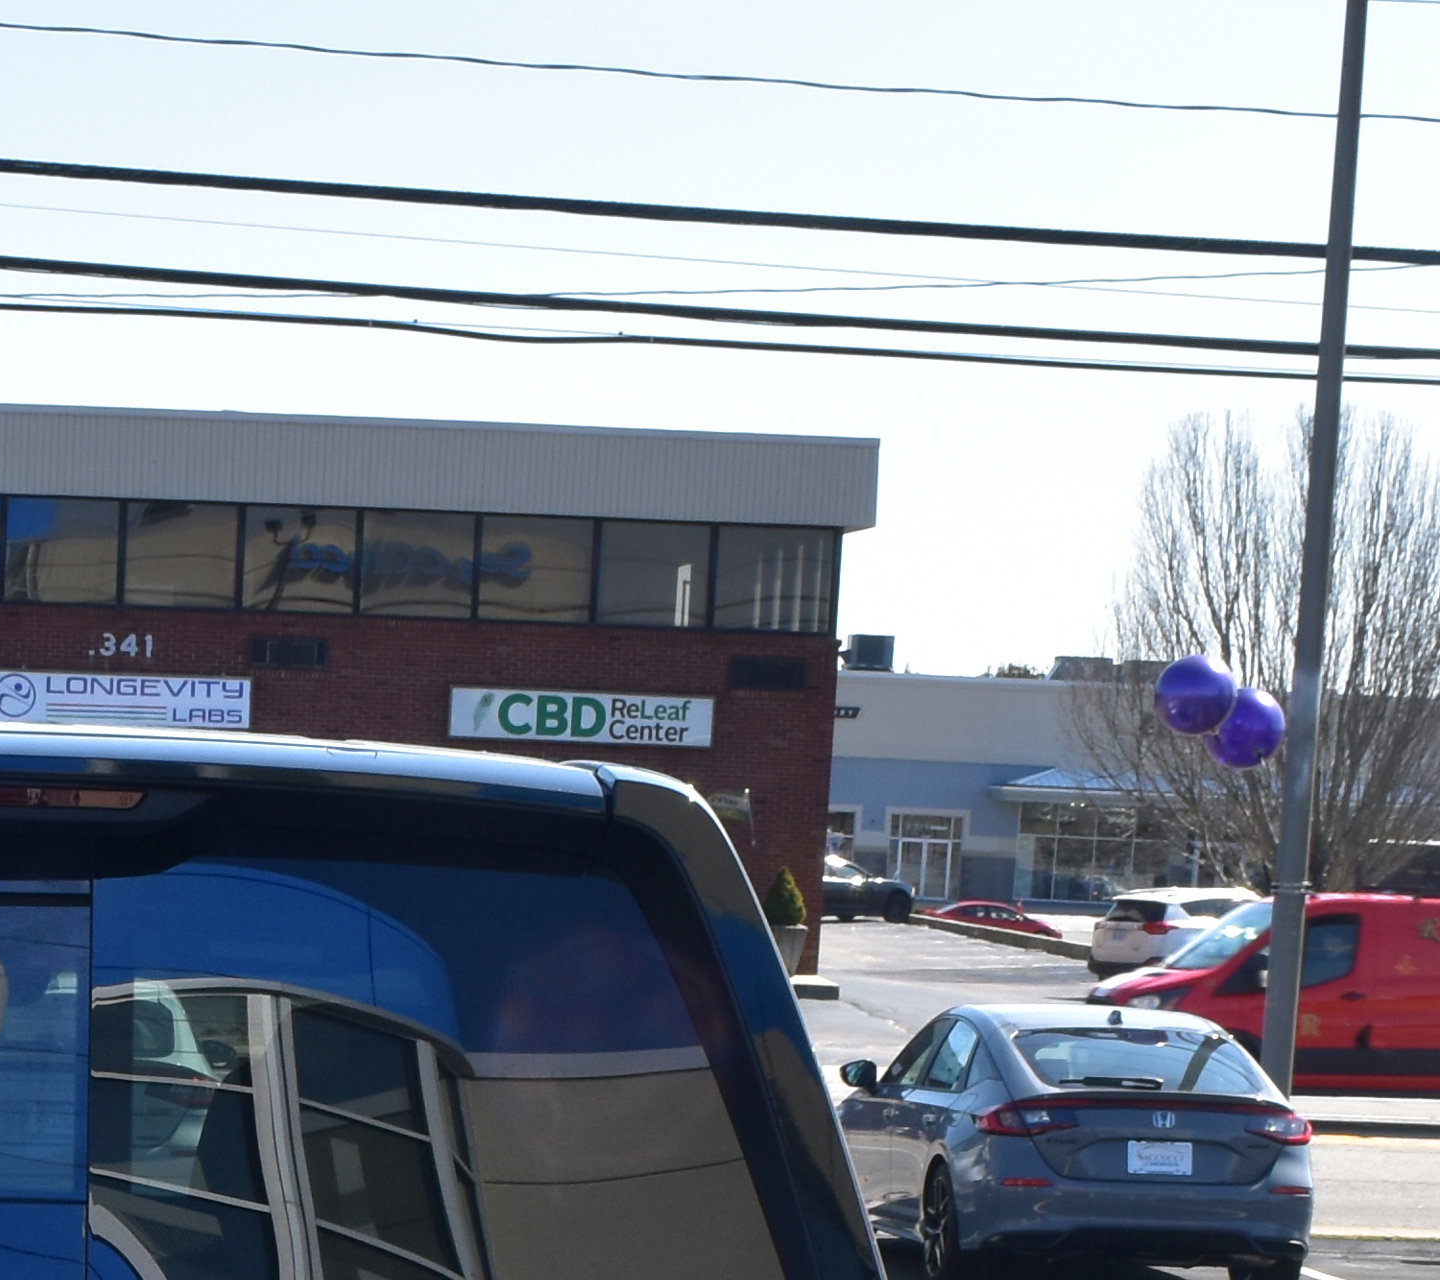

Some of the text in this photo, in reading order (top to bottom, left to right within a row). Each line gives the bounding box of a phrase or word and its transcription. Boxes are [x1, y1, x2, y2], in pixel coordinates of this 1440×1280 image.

[100, 633, 154, 658] 341
[45, 675, 245, 700] LONGEVITY
[172, 707, 244, 724] LABS
[497, 693, 607, 739] CBD
[611, 698, 693, 722] ReLeaf
[610, 720, 690, 744] Center
